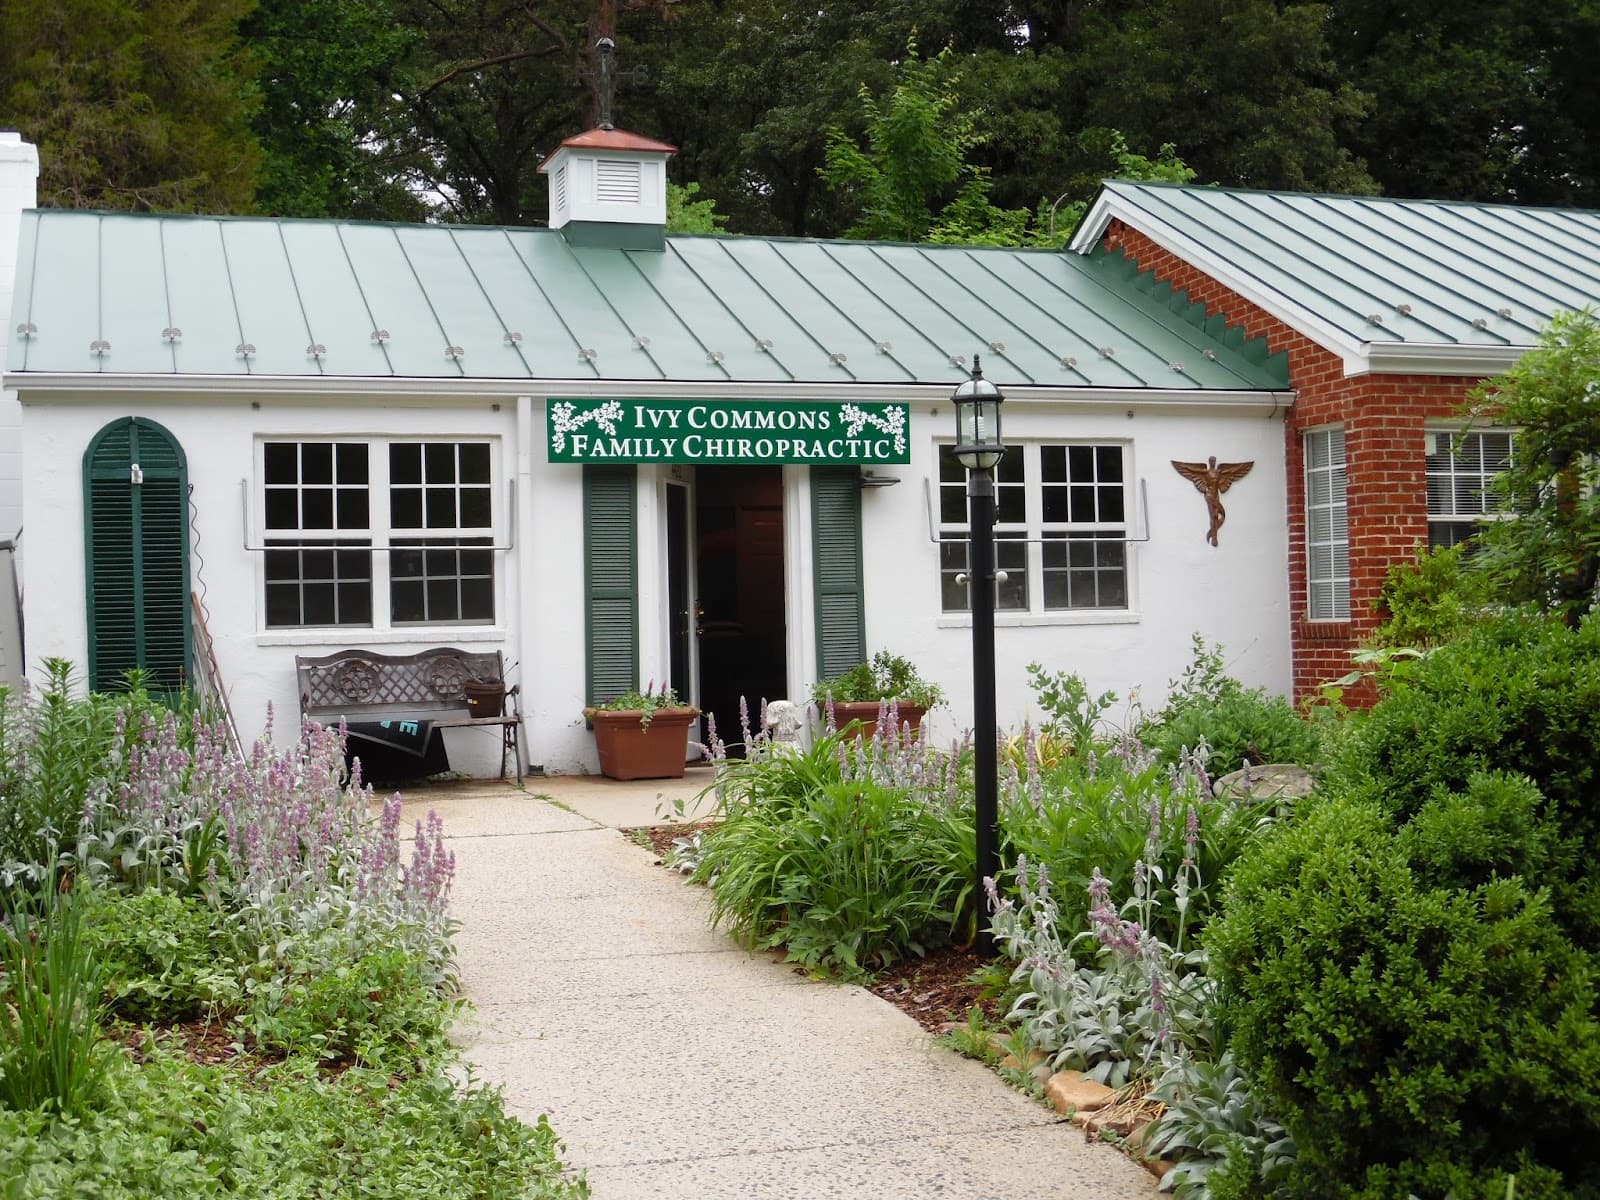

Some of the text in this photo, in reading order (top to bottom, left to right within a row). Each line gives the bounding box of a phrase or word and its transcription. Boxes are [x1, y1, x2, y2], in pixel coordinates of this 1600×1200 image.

[634, 405, 831, 430] IVY COMMONS
[571, 434, 890, 458] FAMILY CHIROPRACTIC
